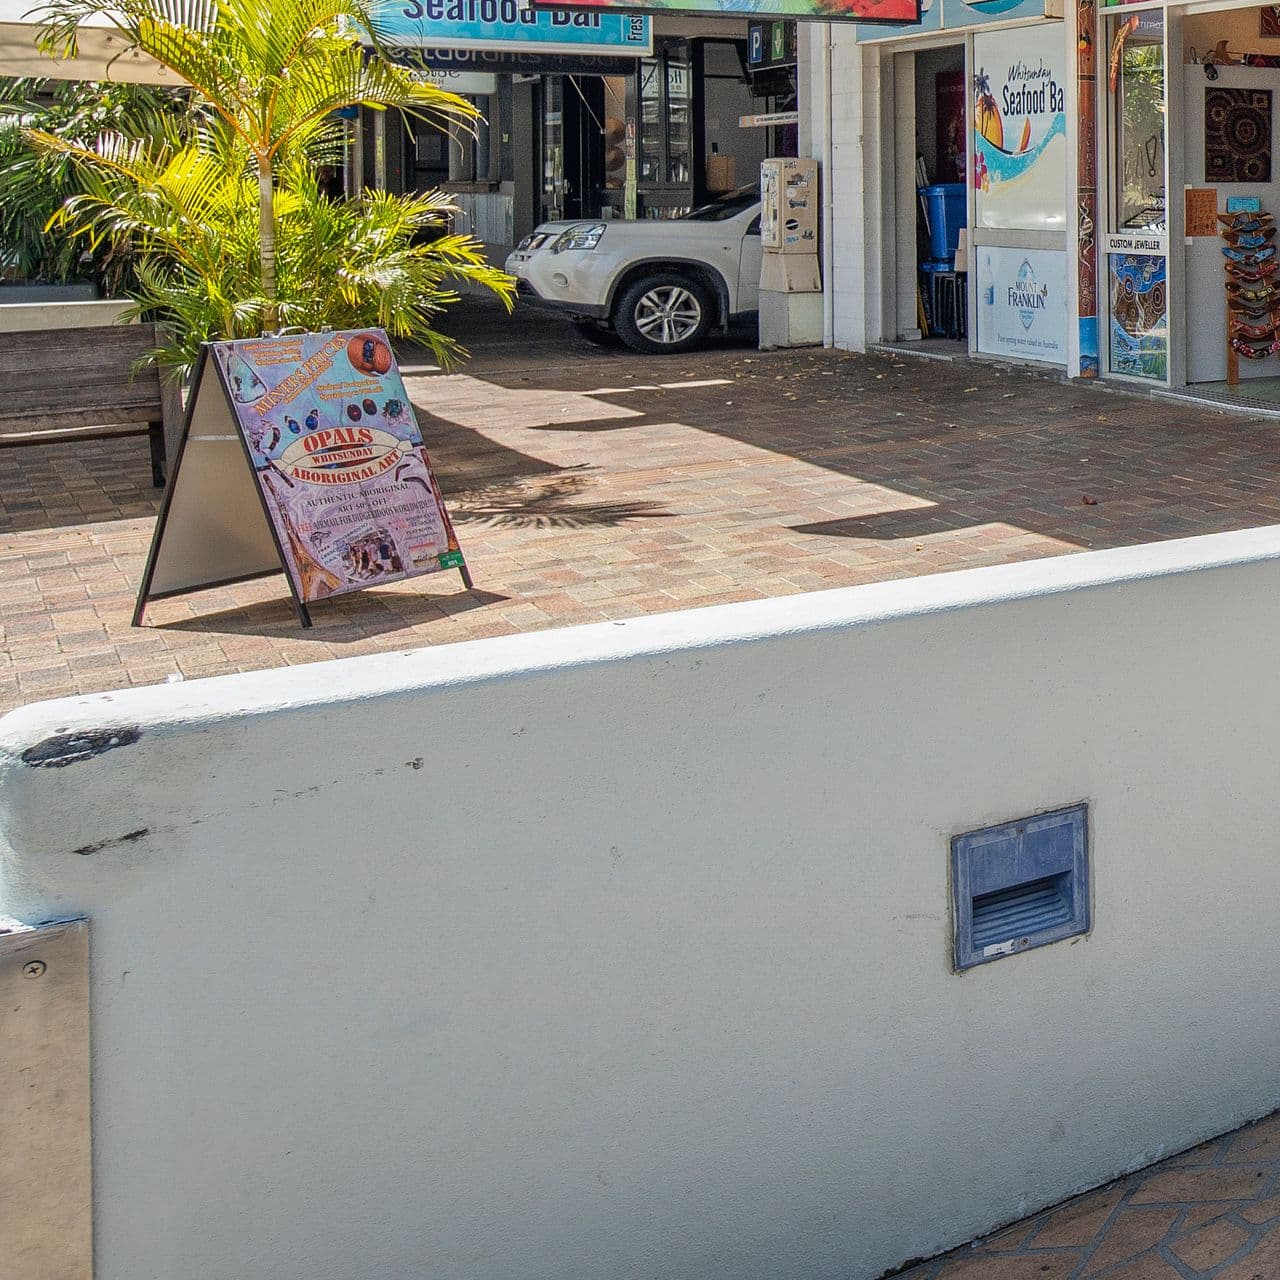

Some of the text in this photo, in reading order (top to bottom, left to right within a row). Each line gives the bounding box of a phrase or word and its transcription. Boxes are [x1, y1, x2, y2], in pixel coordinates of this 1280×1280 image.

[1008, 58, 1051, 86] Whitsunday
[1003, 82, 1045, 116] Seafood
[1110, 239, 1160, 250] CUSTOM JEWELLER
[1008, 287, 1045, 310] FRANKLIN
[1016, 281, 1037, 293] MOUNT
[255, 368, 306, 417] MINERS
[302, 333, 348, 372] PRICES
[304, 428, 374, 452] OPALS
[291, 450, 401, 483] ABORIGINAL ART
[312, 447, 373, 463] WHITSUNDAY
[306, 483, 410, 507] AUTHENTIC ABORIGINAL
[314, 519, 339, 530] AIRMAIL
[352, 508, 393, 522] DIDGERIDOOS
